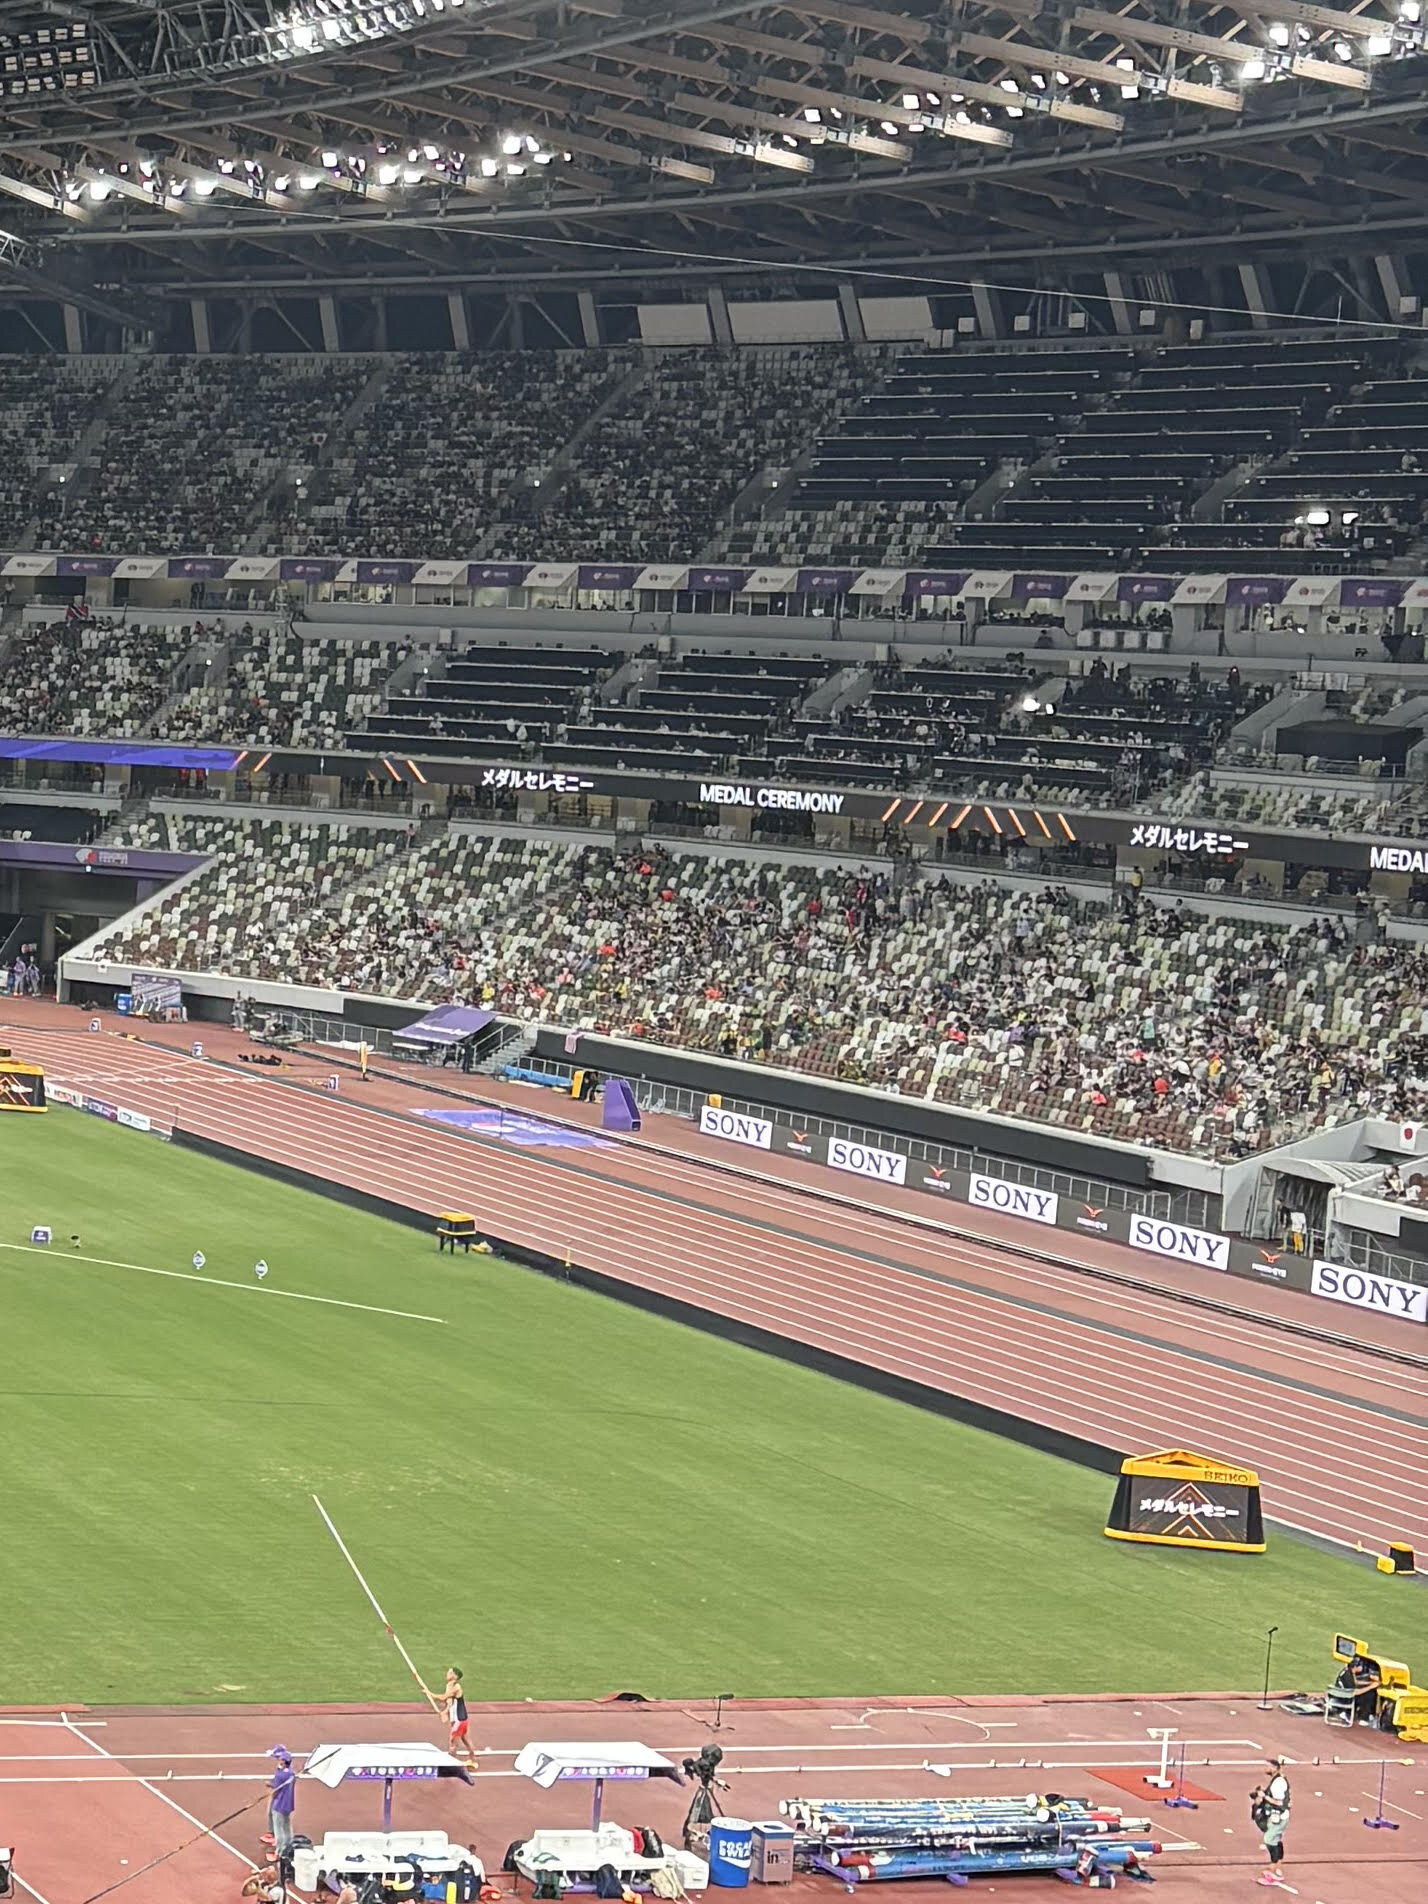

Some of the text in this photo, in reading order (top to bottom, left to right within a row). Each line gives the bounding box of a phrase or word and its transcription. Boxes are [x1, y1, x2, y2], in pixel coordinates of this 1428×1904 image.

[481, 768, 594, 793] メダルセレモニー
[699, 783, 844, 815] MEDAL CEREMONY
[1130, 824, 1249, 854] メダルセレモニー
[705, 1111, 768, 1143] SONY
[833, 1143, 902, 1178] SONY
[975, 1179, 1053, 1217] SONY
[1136, 1221, 1224, 1262] SONY
[1319, 1267, 1421, 1313] SONY
[1204, 1470, 1248, 1483] SEIKO
